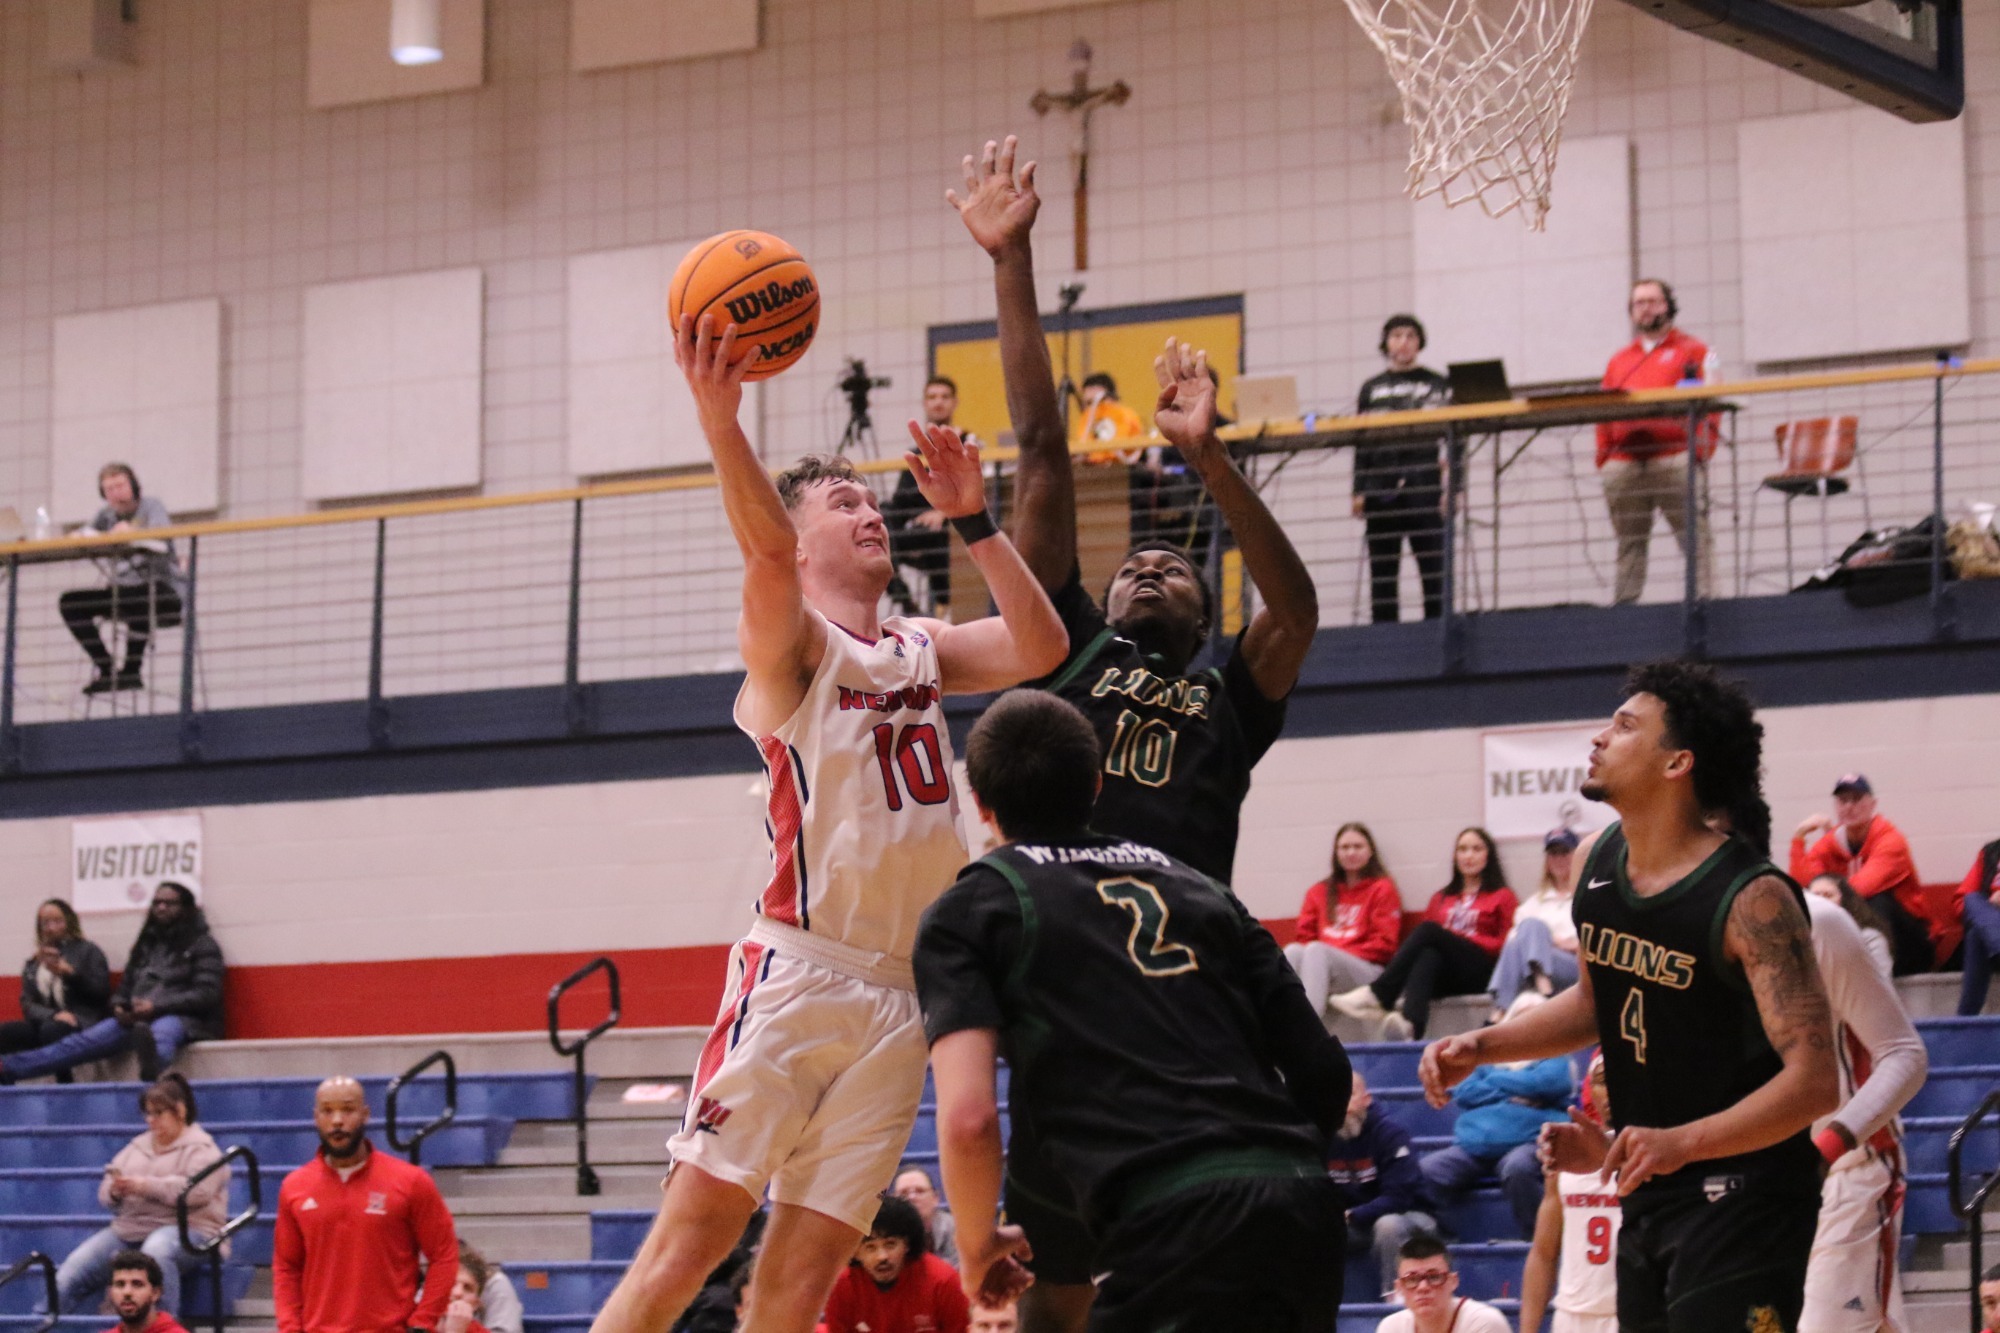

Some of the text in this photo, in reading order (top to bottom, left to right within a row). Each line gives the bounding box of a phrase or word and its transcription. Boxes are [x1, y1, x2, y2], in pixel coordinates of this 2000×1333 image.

[723, 275, 814, 324] Wilson
[1091, 667, 1211, 720] LIONS
[872, 722, 951, 812] 10
[1105, 708, 1178, 788] 10
[77, 841, 197, 880] VISITORS
[1096, 875, 1199, 977] 2
[1580, 922, 1697, 990] LIONS
[1620, 987, 1647, 1064] 4
[1586, 1216, 1612, 1265] 9
